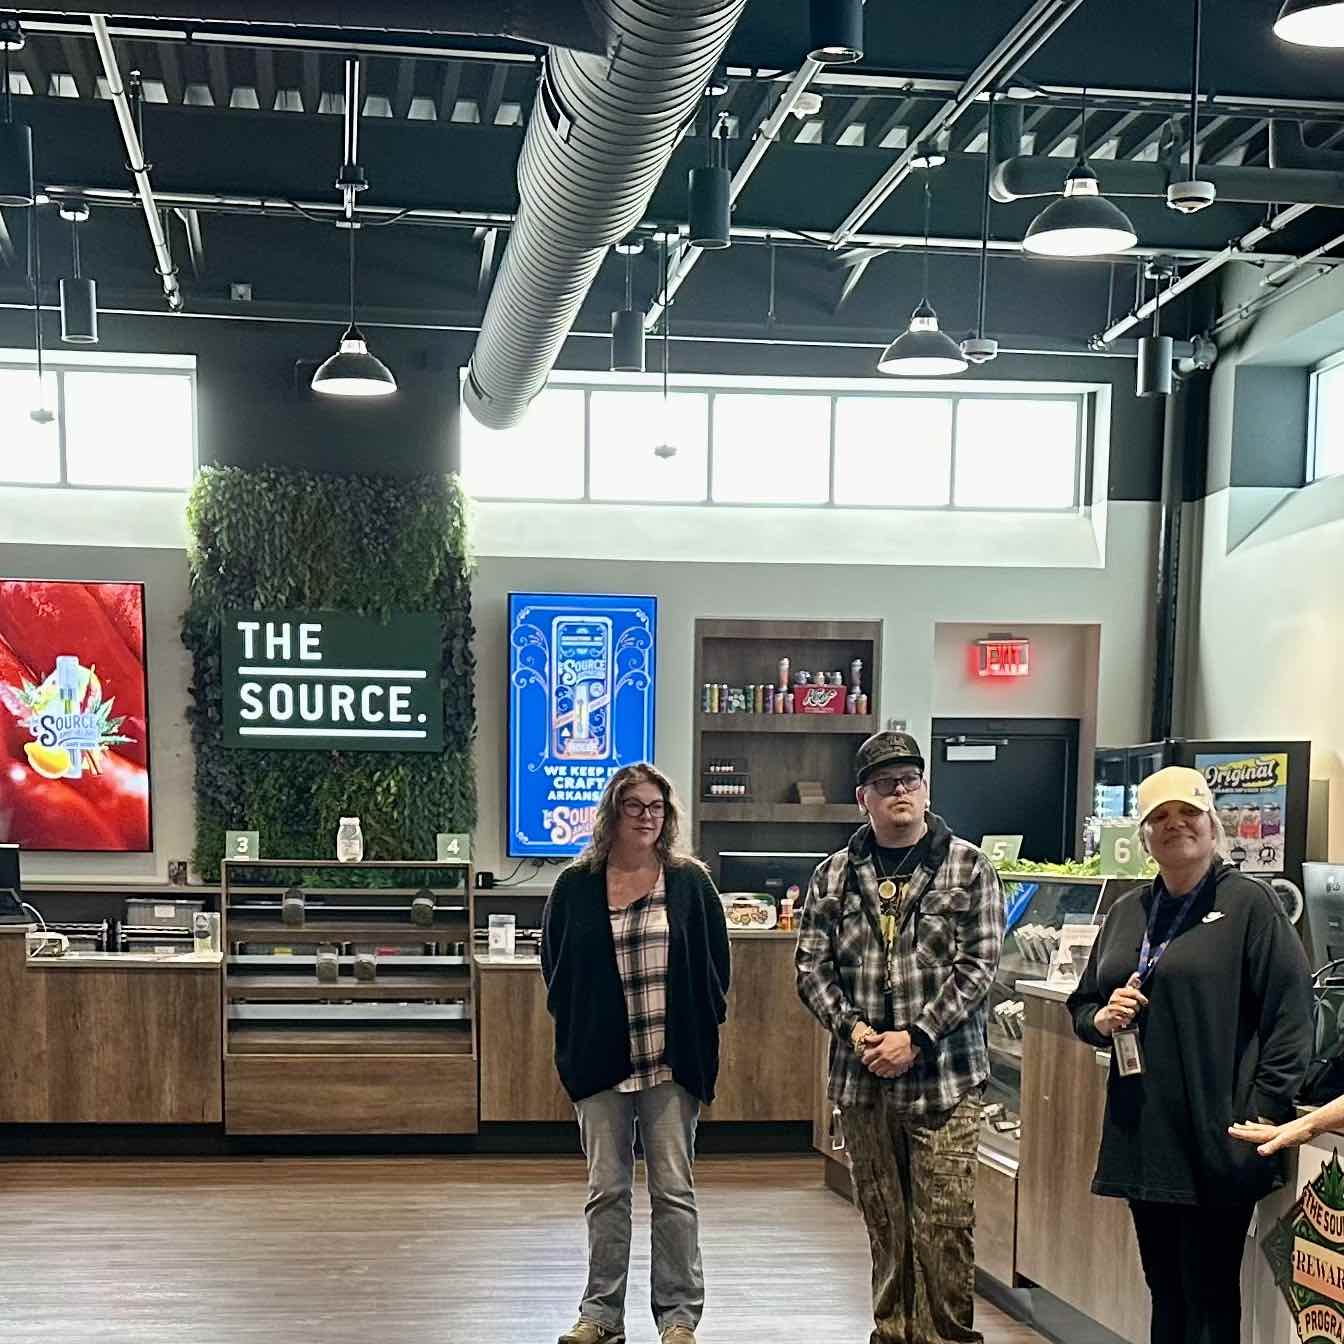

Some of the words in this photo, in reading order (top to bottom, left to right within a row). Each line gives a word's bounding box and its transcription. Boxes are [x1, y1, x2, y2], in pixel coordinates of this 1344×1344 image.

[237, 621, 323, 660] THE
[240, 682, 427, 723] SOURCE.
[543, 766, 567, 776] WE
[571, 766, 604, 777] KEEP
[236, 836, 249, 852] 3
[447, 839, 460, 854] 4
[992, 841, 1009, 861] 5
[1114, 838, 1131, 864] 6
[1306, 1190, 1323, 1226] THE
